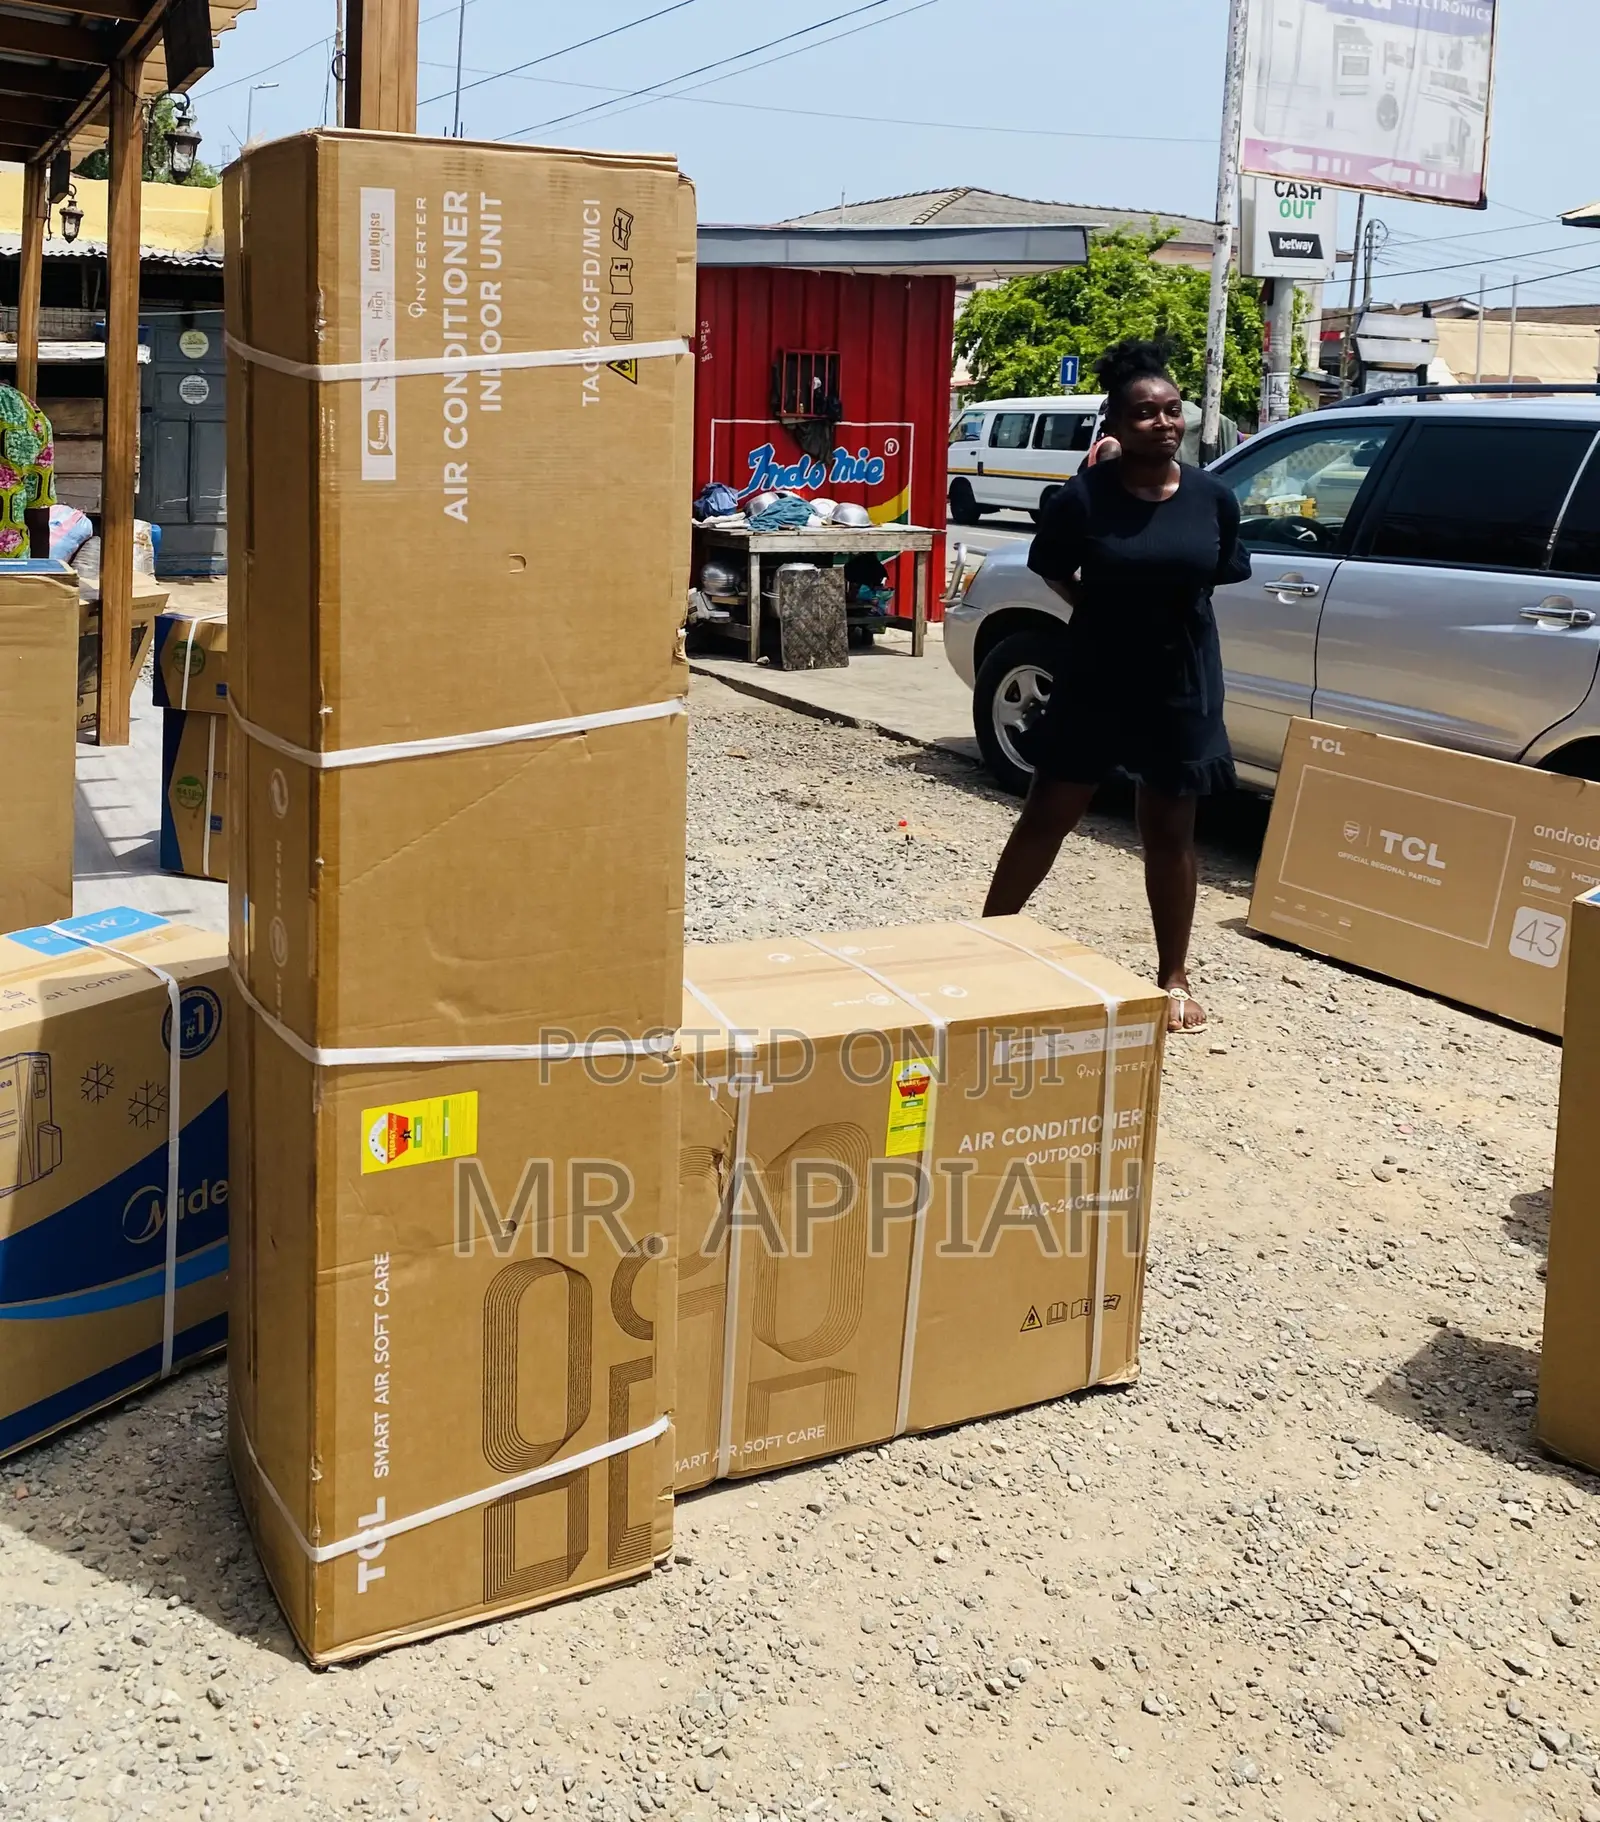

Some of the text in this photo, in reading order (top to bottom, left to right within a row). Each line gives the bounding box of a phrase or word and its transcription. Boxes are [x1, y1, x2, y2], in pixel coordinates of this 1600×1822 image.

[1397, 0, 1491, 21] CTRONICS
[1274, 180, 1322, 200] CASH
[1280, 199, 1316, 219] OUT
[368, 211, 386, 273] Low Noise
[480, 192, 502, 271] UNIT
[1279, 237, 1314, 254] betway
[371, 291, 386, 320] High
[443, 462, 469, 524] AIR
[1309, 735, 1346, 757] TCL
[1379, 829, 1446, 869] TCL
[1337, 851, 1442, 886] OFFICIAL REGIONAL PARTNER
[1515, 918, 1562, 958] 43
[44, 990, 69, 1001] at
[68, 972, 134, 993] home
[186, 1004, 205, 1040] #1
[1076, 1060, 1147, 1079] INVRTER
[958, 1108, 1144, 1154] AIR CONDITIOER
[1026, 1143, 1101, 1166] OUTDOOR
[122, 1179, 228, 1244] Mide
[373, 1251, 390, 1308] CARE
[374, 1411, 390, 1479] SMART
[787, 1424, 827, 1445] CARE
[357, 1496, 386, 1594] TCL
